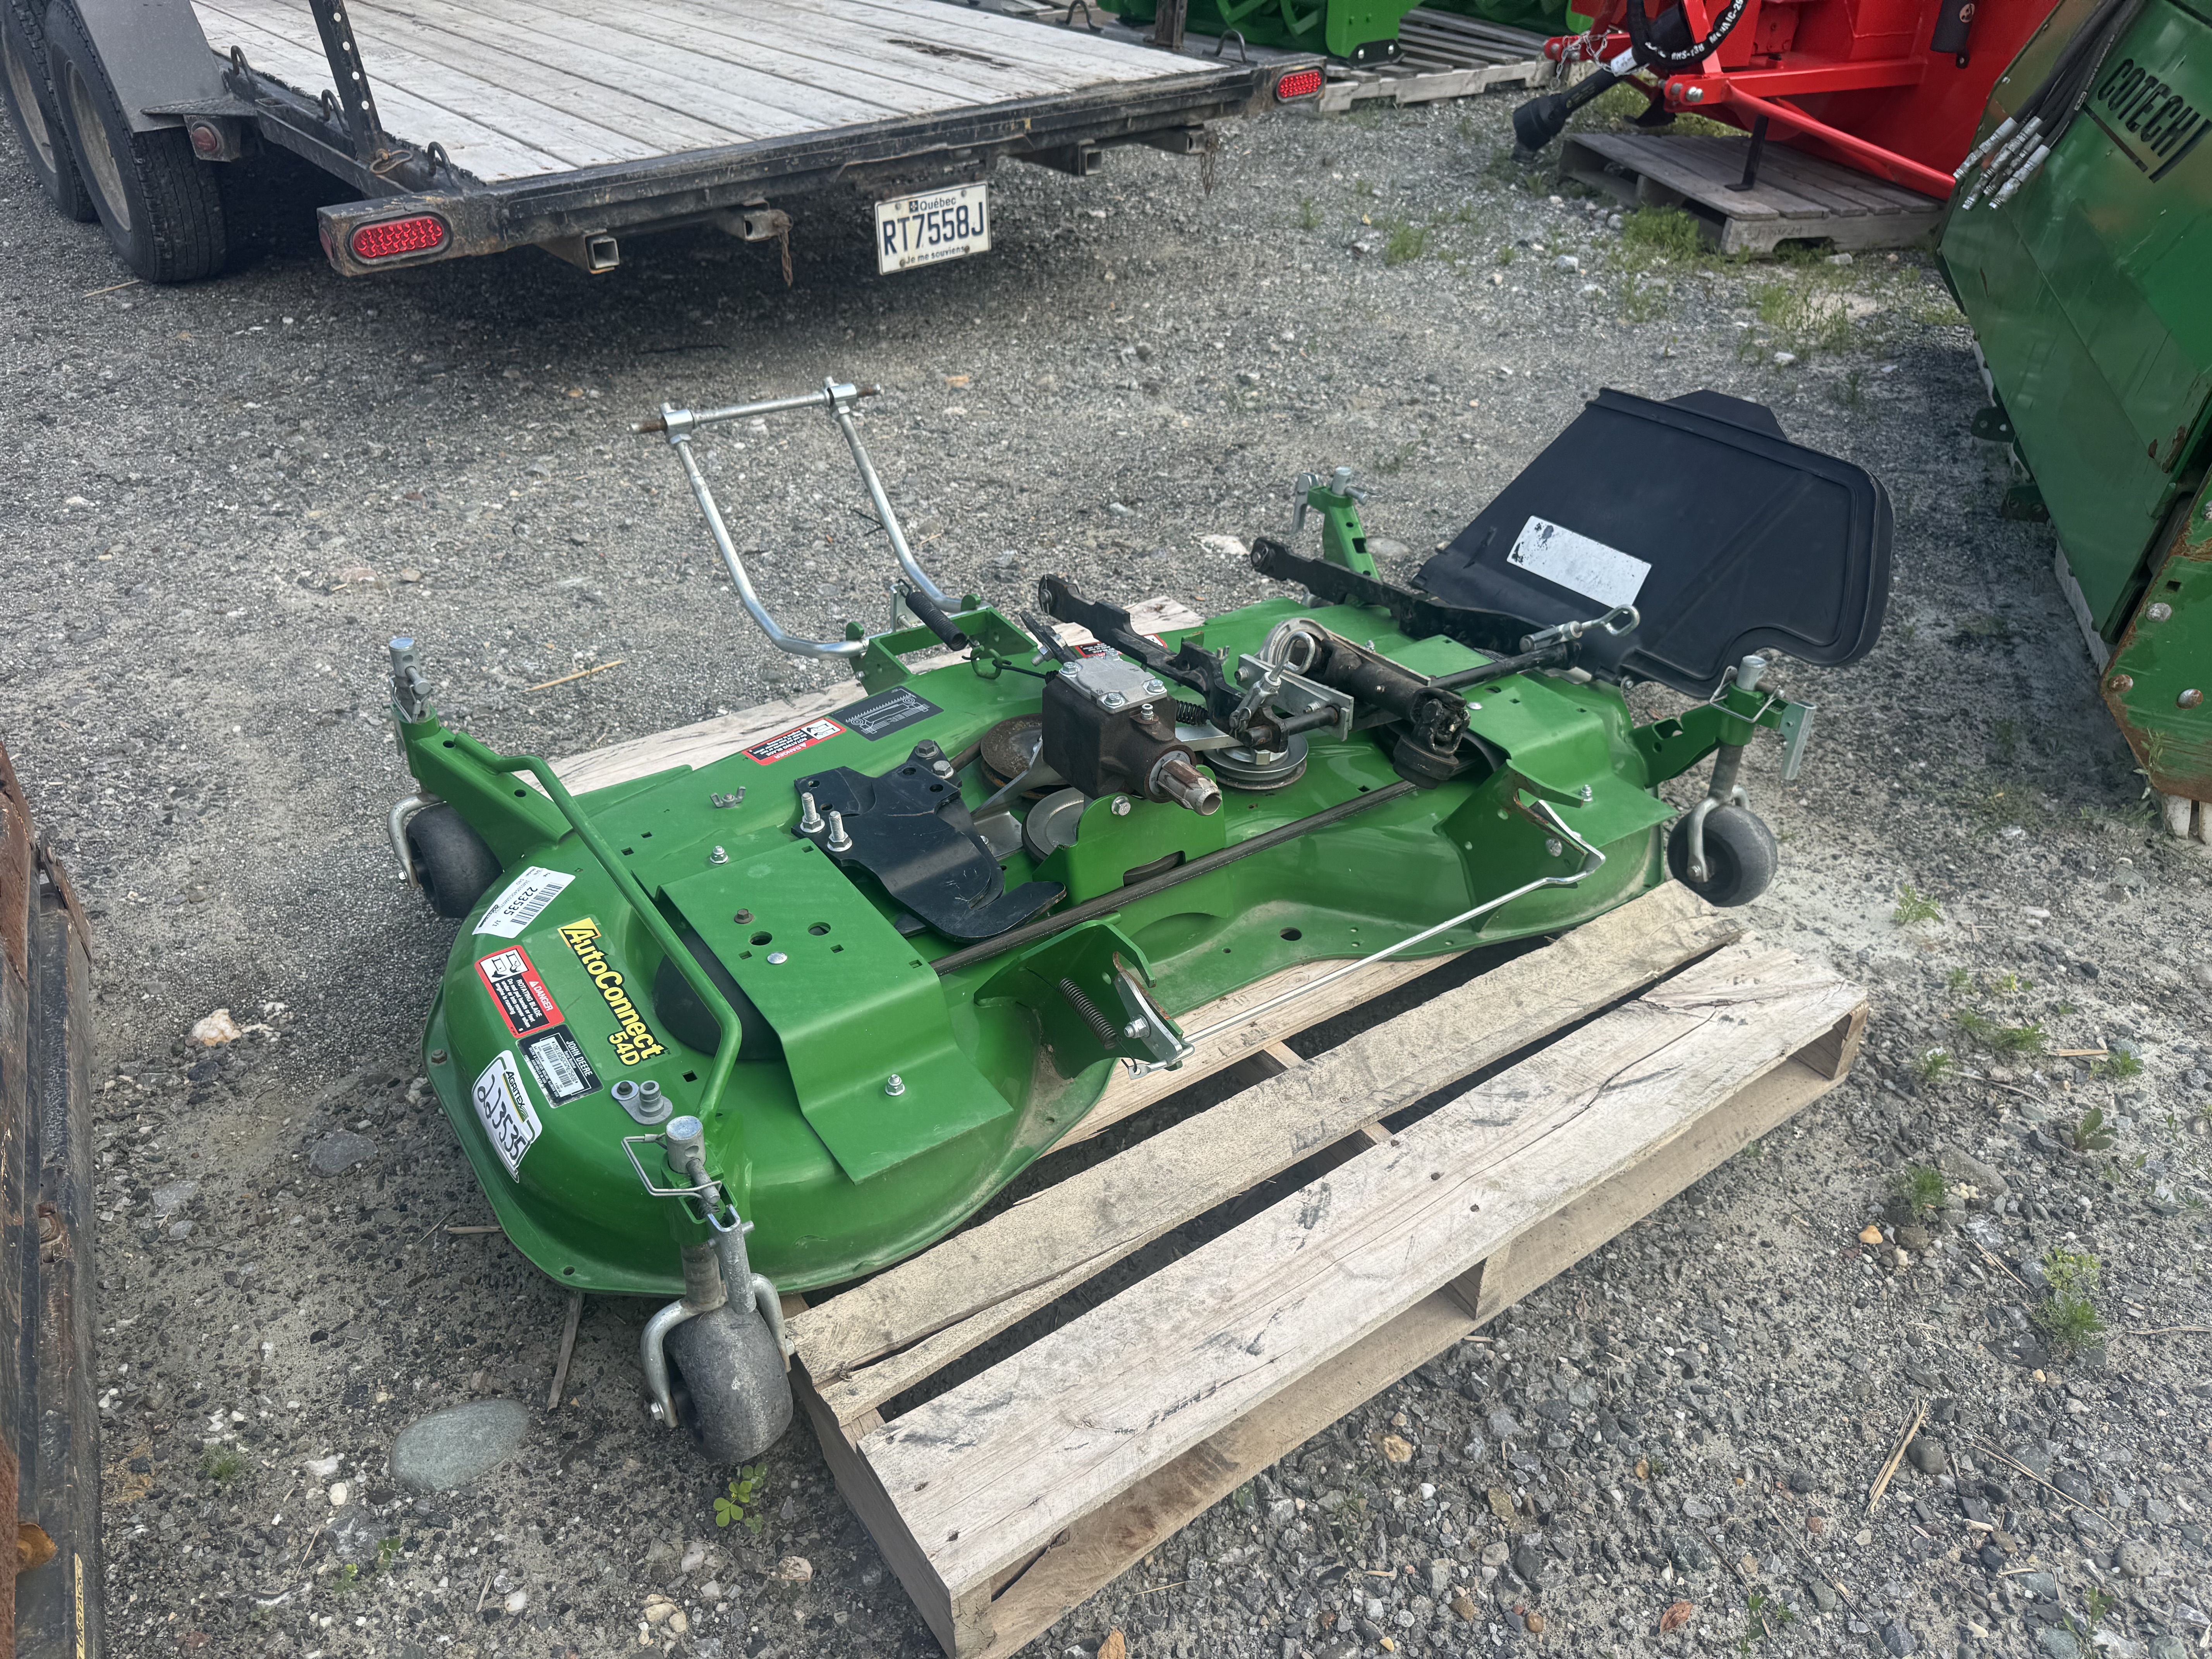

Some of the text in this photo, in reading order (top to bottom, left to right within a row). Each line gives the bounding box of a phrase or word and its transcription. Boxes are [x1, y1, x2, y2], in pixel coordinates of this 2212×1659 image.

[2098, 58, 2200, 157] COTECH
[920, 197, 957, 211] Québec
[883, 202, 984, 256] RT7558J
[906, 247, 965, 264] Je me souviens
[504, 887, 538, 915] 223535
[495, 983, 505, 996] engine
[504, 1000, 516, 1015] running
[501, 981, 510, 991] under
[522, 1017, 531, 1028] when
[516, 979, 542, 1018] ROTATING BLADE
[518, 997, 527, 1010] hands
[533, 986, 553, 1011] DANGER
[562, 929, 665, 1060] AutoConnect
[566, 1041, 593, 1077] JOHN DEERE
[609, 1032, 642, 1066] 54D
[505, 1072, 525, 1109] AGRITEX
[477, 1074, 526, 1161] 223535
